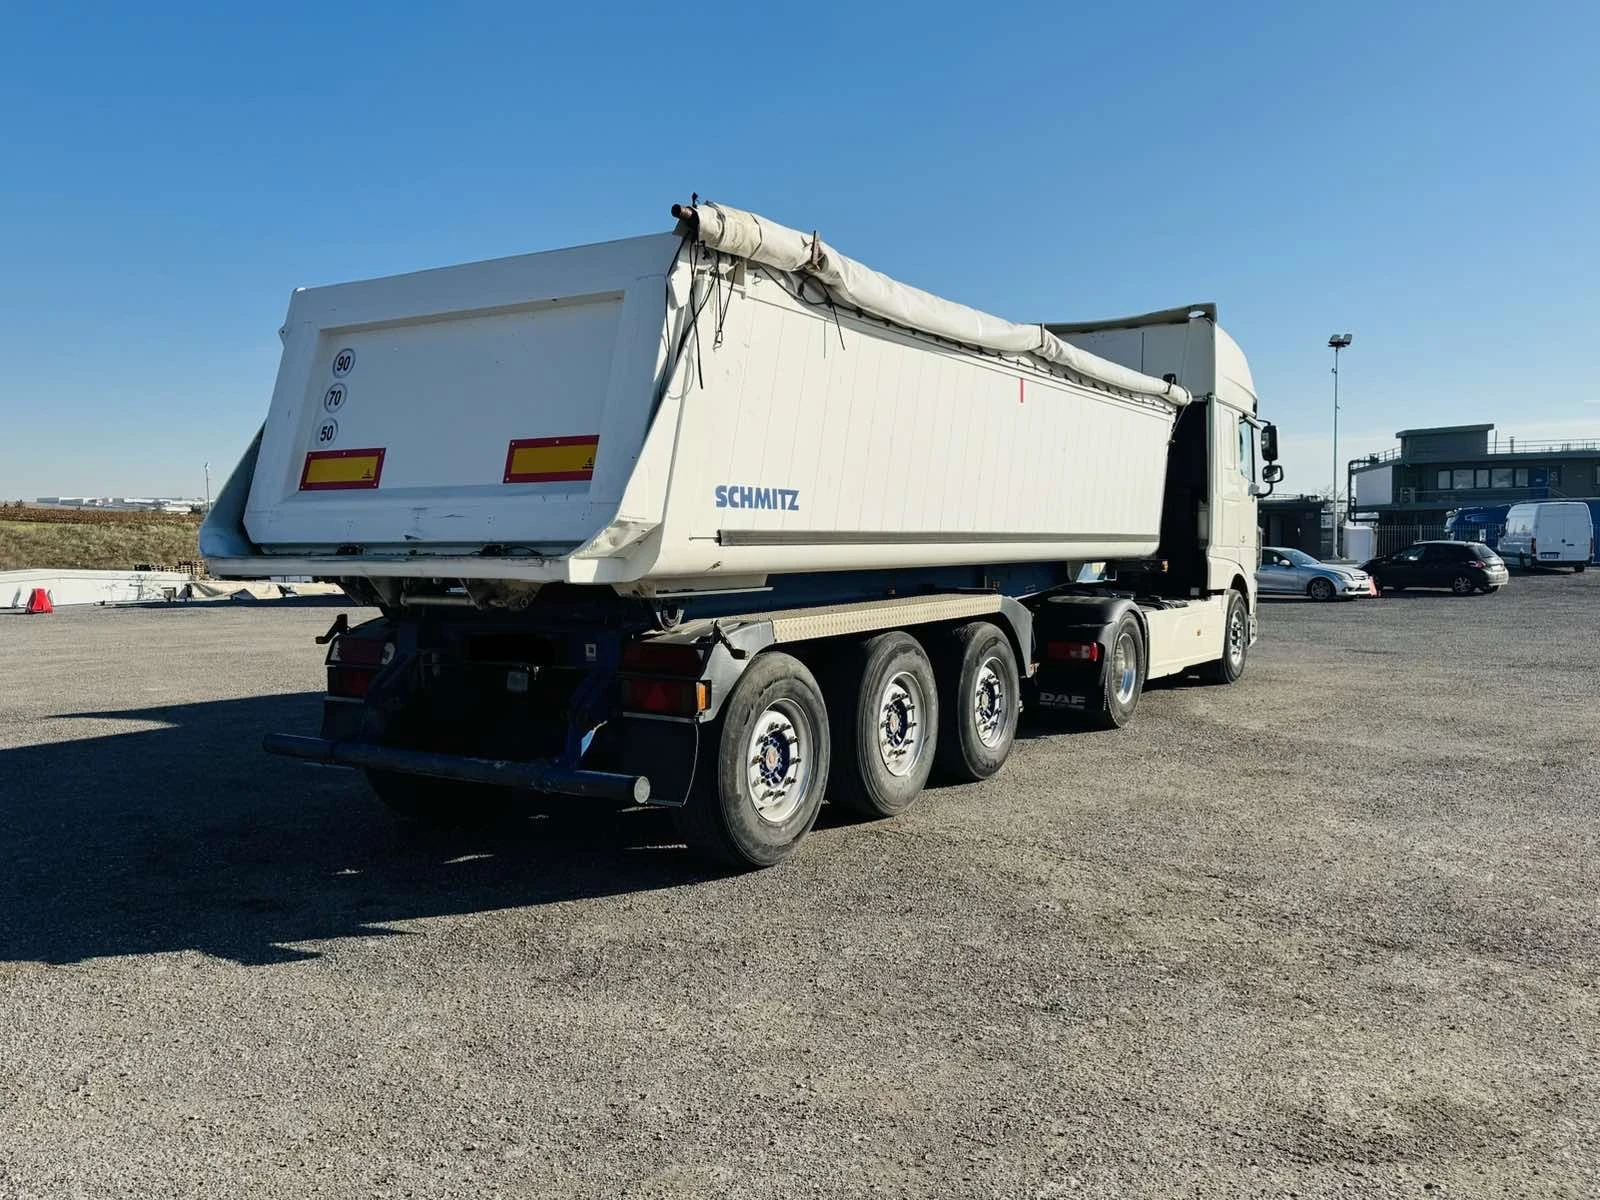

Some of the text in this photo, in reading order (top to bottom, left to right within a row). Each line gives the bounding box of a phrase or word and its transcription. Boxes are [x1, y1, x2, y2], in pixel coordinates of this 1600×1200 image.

[336, 356, 351, 371] 90
[328, 390, 342, 406] 70
[320, 425, 334, 442] 50
[715, 485, 800, 511] SCHMITZ
[1040, 692, 1086, 704] DAF
